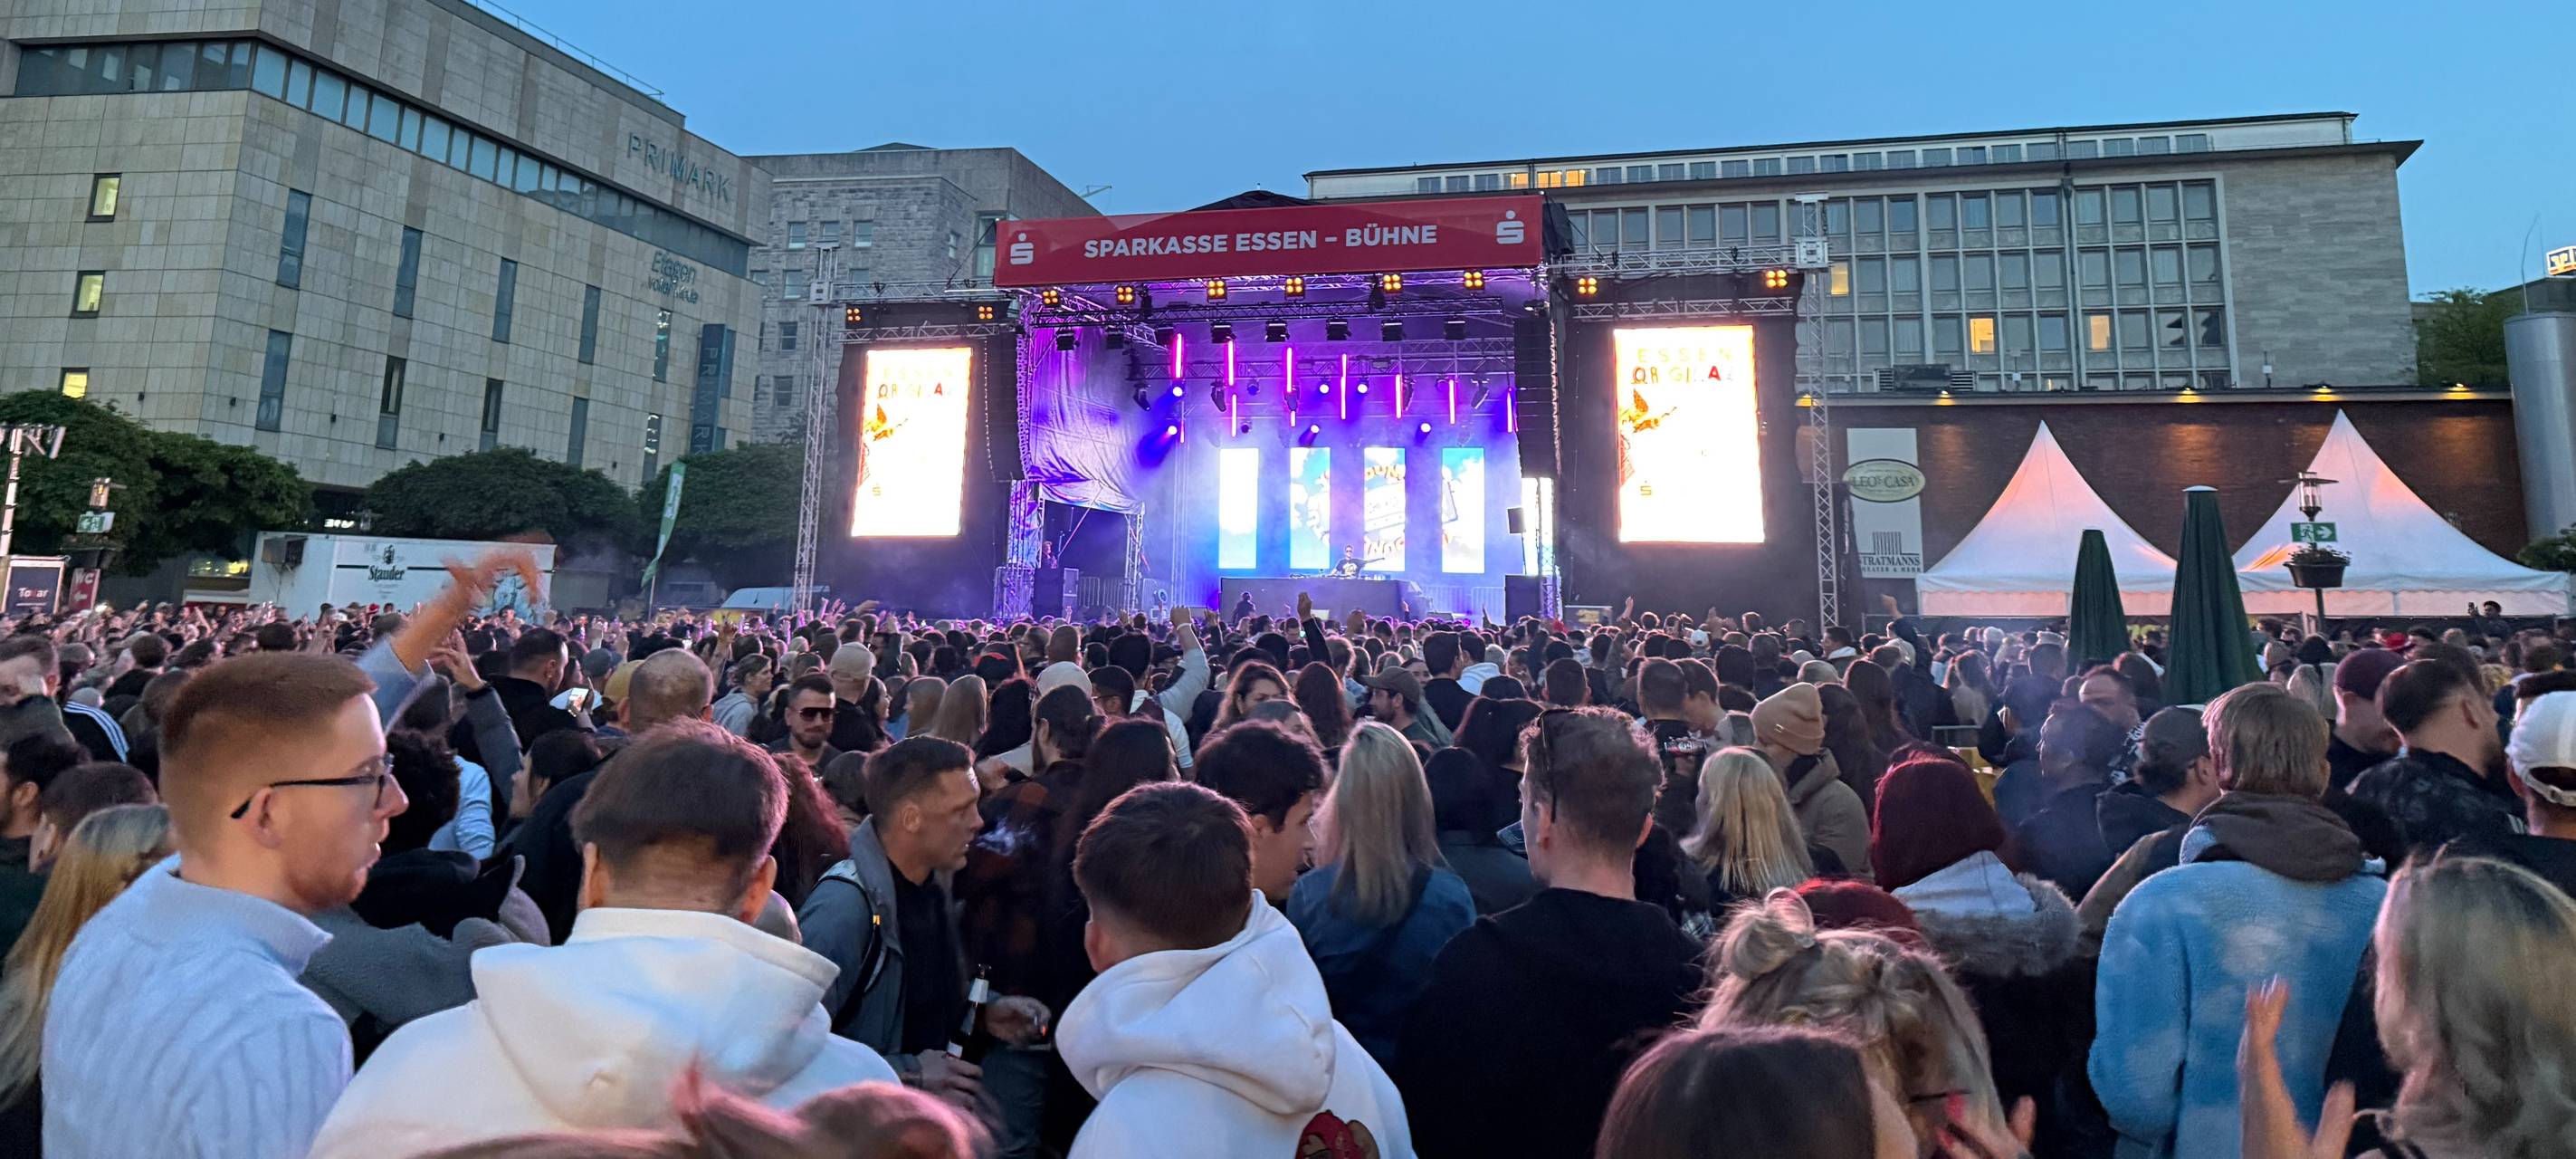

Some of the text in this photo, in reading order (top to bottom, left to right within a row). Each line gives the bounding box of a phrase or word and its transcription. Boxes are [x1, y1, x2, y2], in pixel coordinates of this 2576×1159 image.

[627, 132, 730, 203] PRIMARK
[1084, 235, 1227, 257] SPARKASSE
[1236, 231, 1317, 252] ESSEN
[1345, 224, 1437, 246] BÜHNE
[693, 347, 719, 455] PRIMARK
[1884, 475, 1915, 489] CASA
[1861, 556, 1921, 566] TRATMANNS
[74, 572, 94, 585] WC
[368, 565, 405, 581] Stauder
